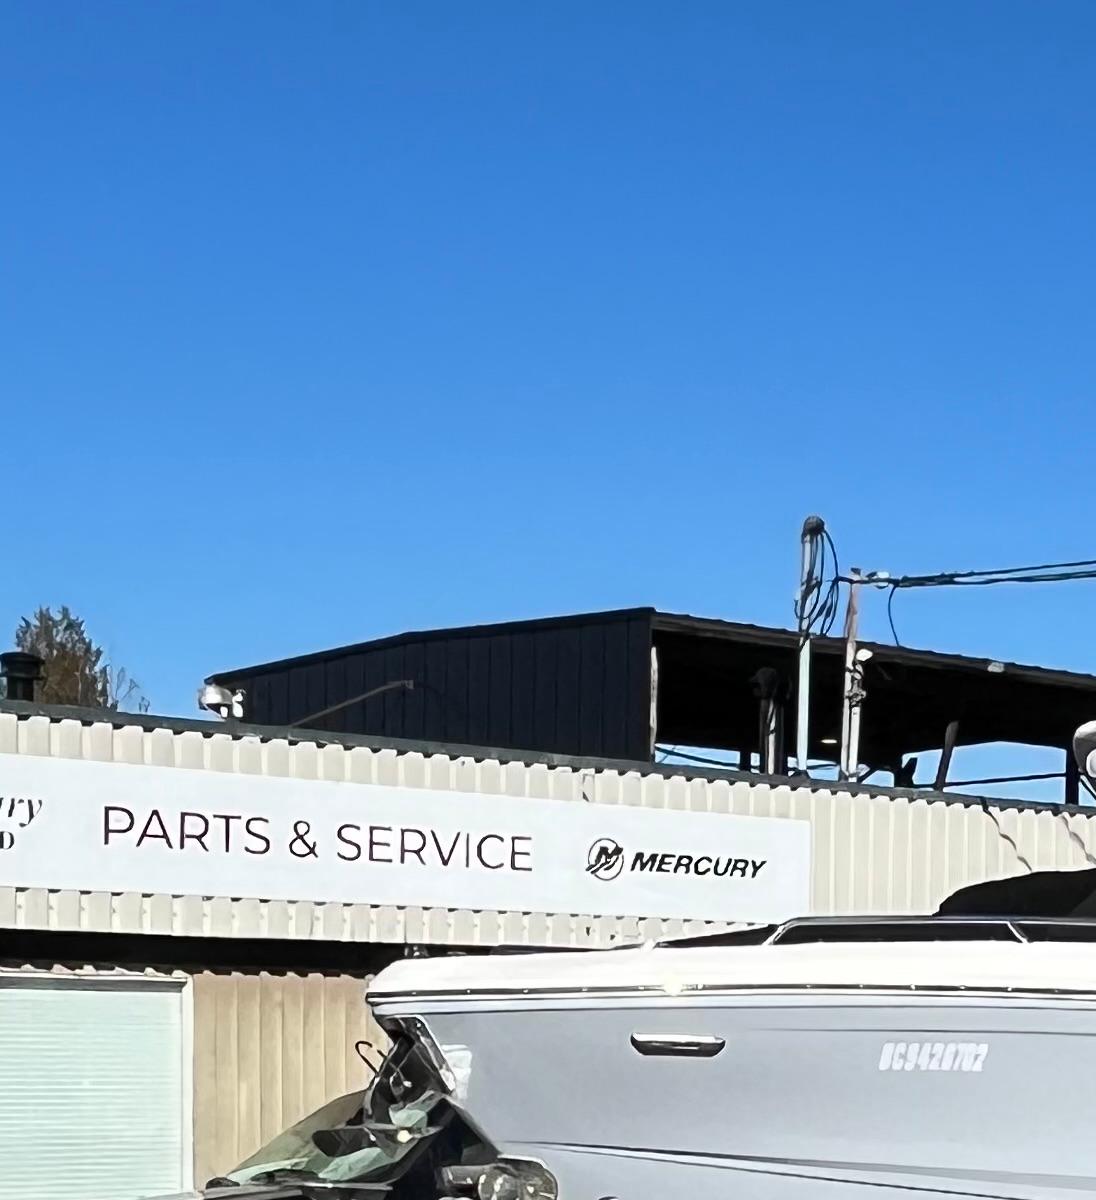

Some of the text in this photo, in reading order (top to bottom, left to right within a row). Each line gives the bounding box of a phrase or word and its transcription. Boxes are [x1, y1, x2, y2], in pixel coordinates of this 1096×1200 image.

[103, 805, 533, 872] PARTS & SERVICE
[630, 851, 767, 879] MERCURY
